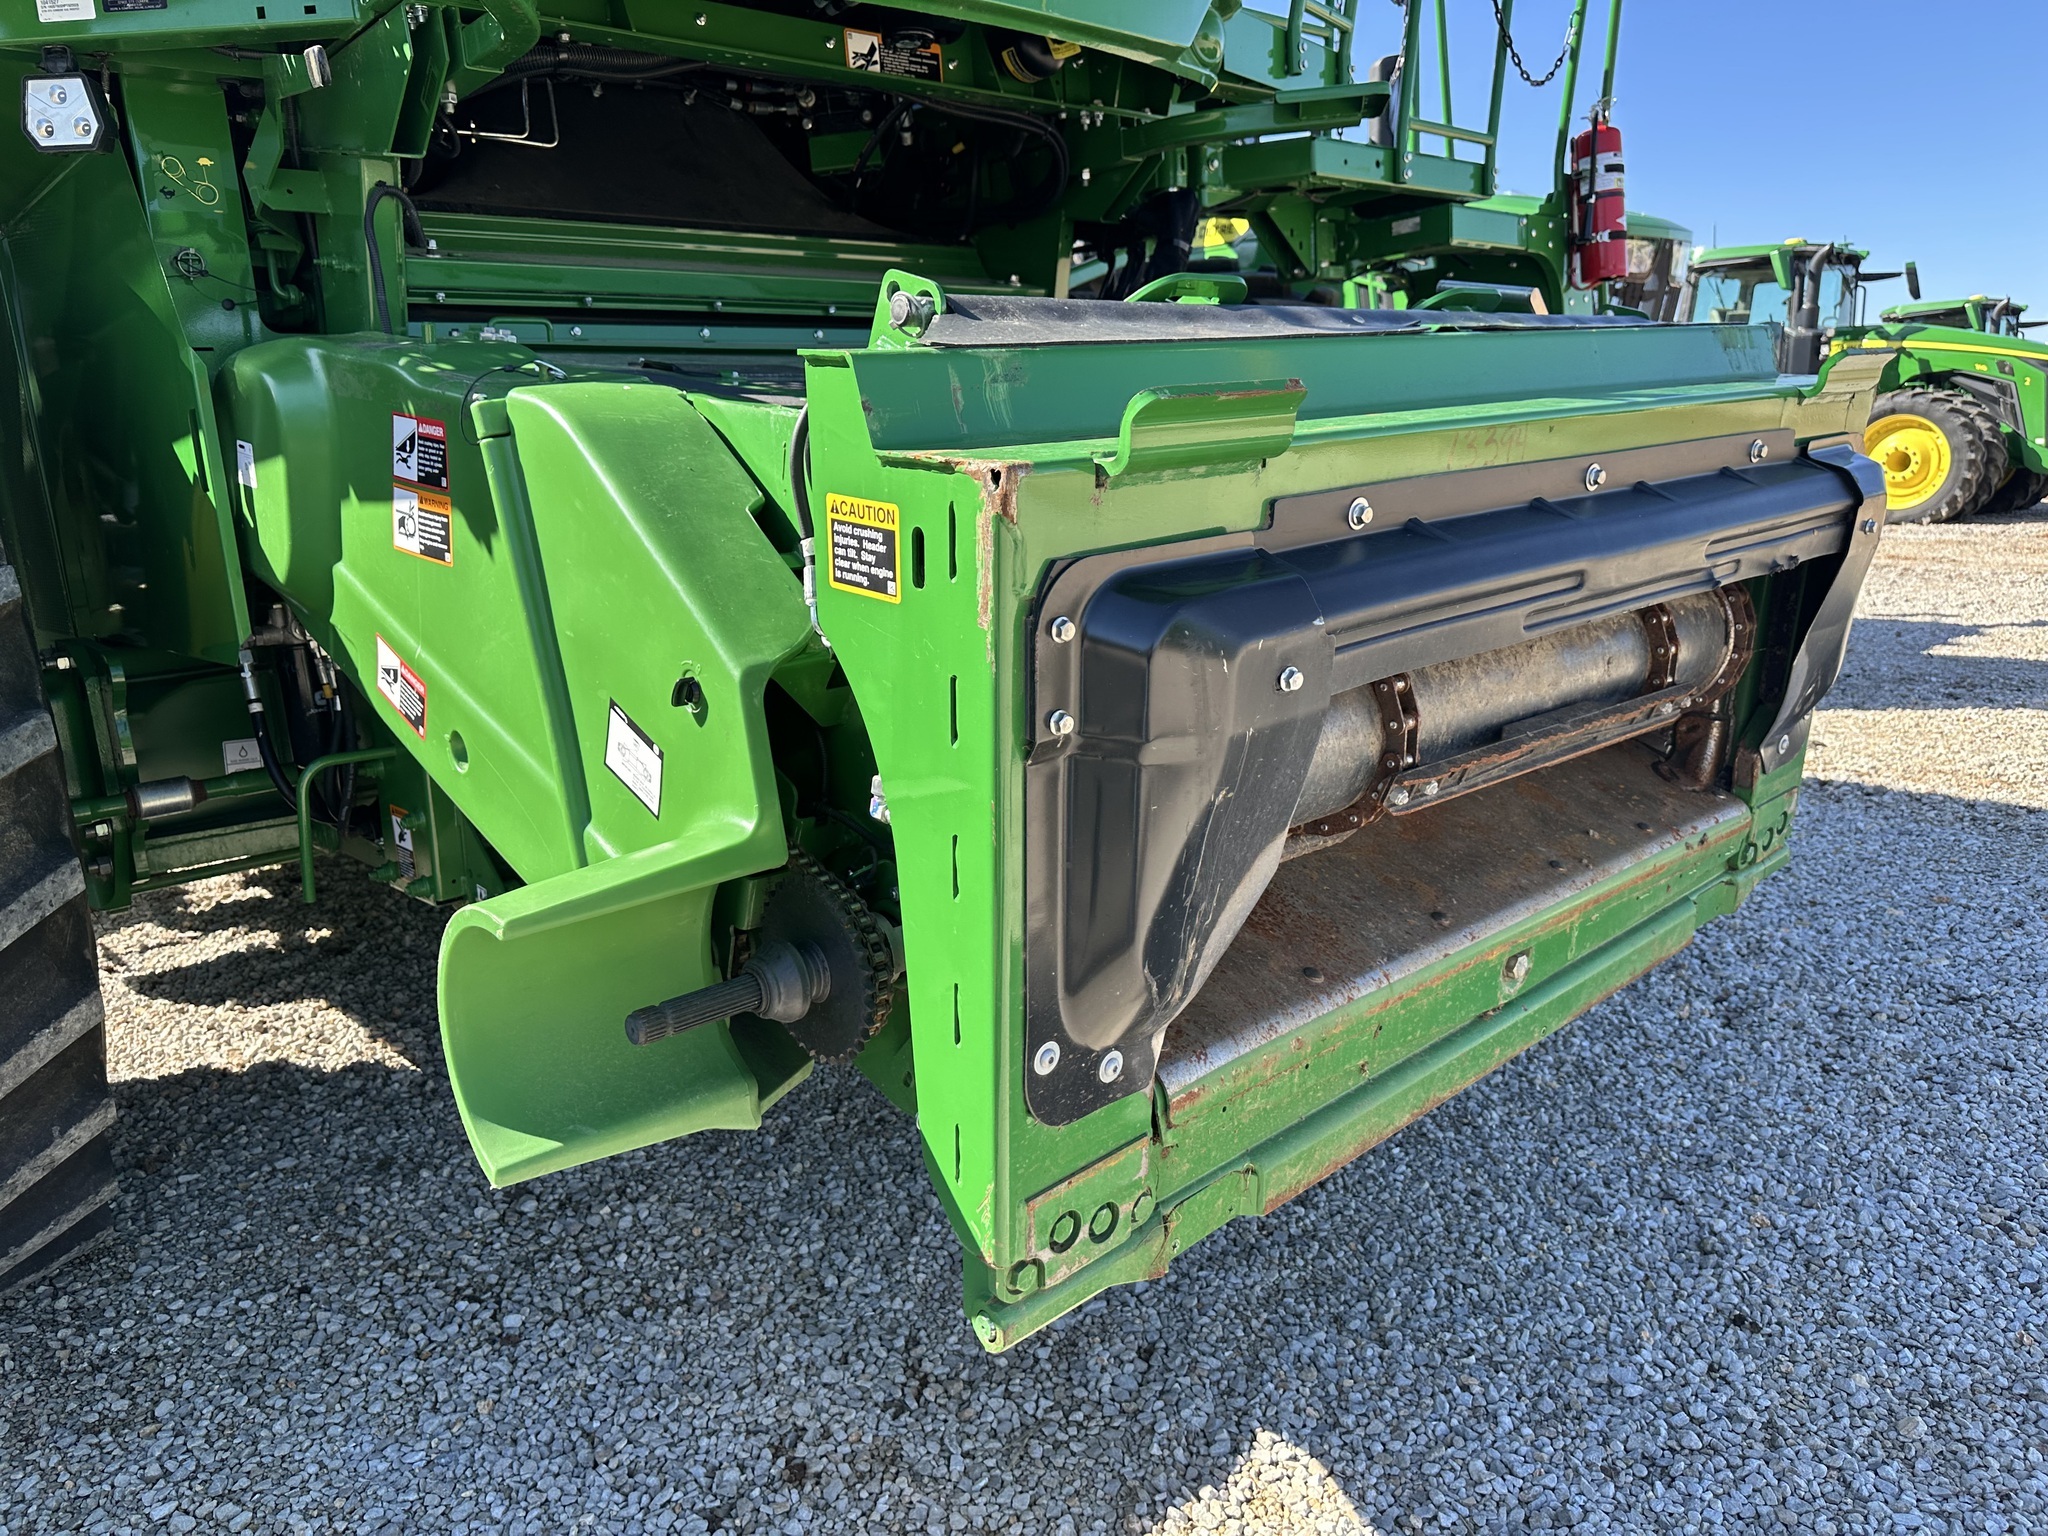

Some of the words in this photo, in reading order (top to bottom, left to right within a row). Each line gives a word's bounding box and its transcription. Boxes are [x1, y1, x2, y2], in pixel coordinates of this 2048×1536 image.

[422, 423, 444, 437] DANGER
[839, 500, 895, 525] CAUTION
[833, 521, 852, 534] Avoid
[853, 527, 883, 543] crushing
[833, 533, 860, 547] injuries.
[862, 539, 887, 553] Header
[834, 546, 846, 556] can
[847, 547, 858, 559] tilt.
[861, 551, 876, 565] Stay
[835, 558, 850, 568] clear
[852, 561, 870, 573] when
[871, 567, 893, 579] engine
[842, 570, 869, 587] running.
